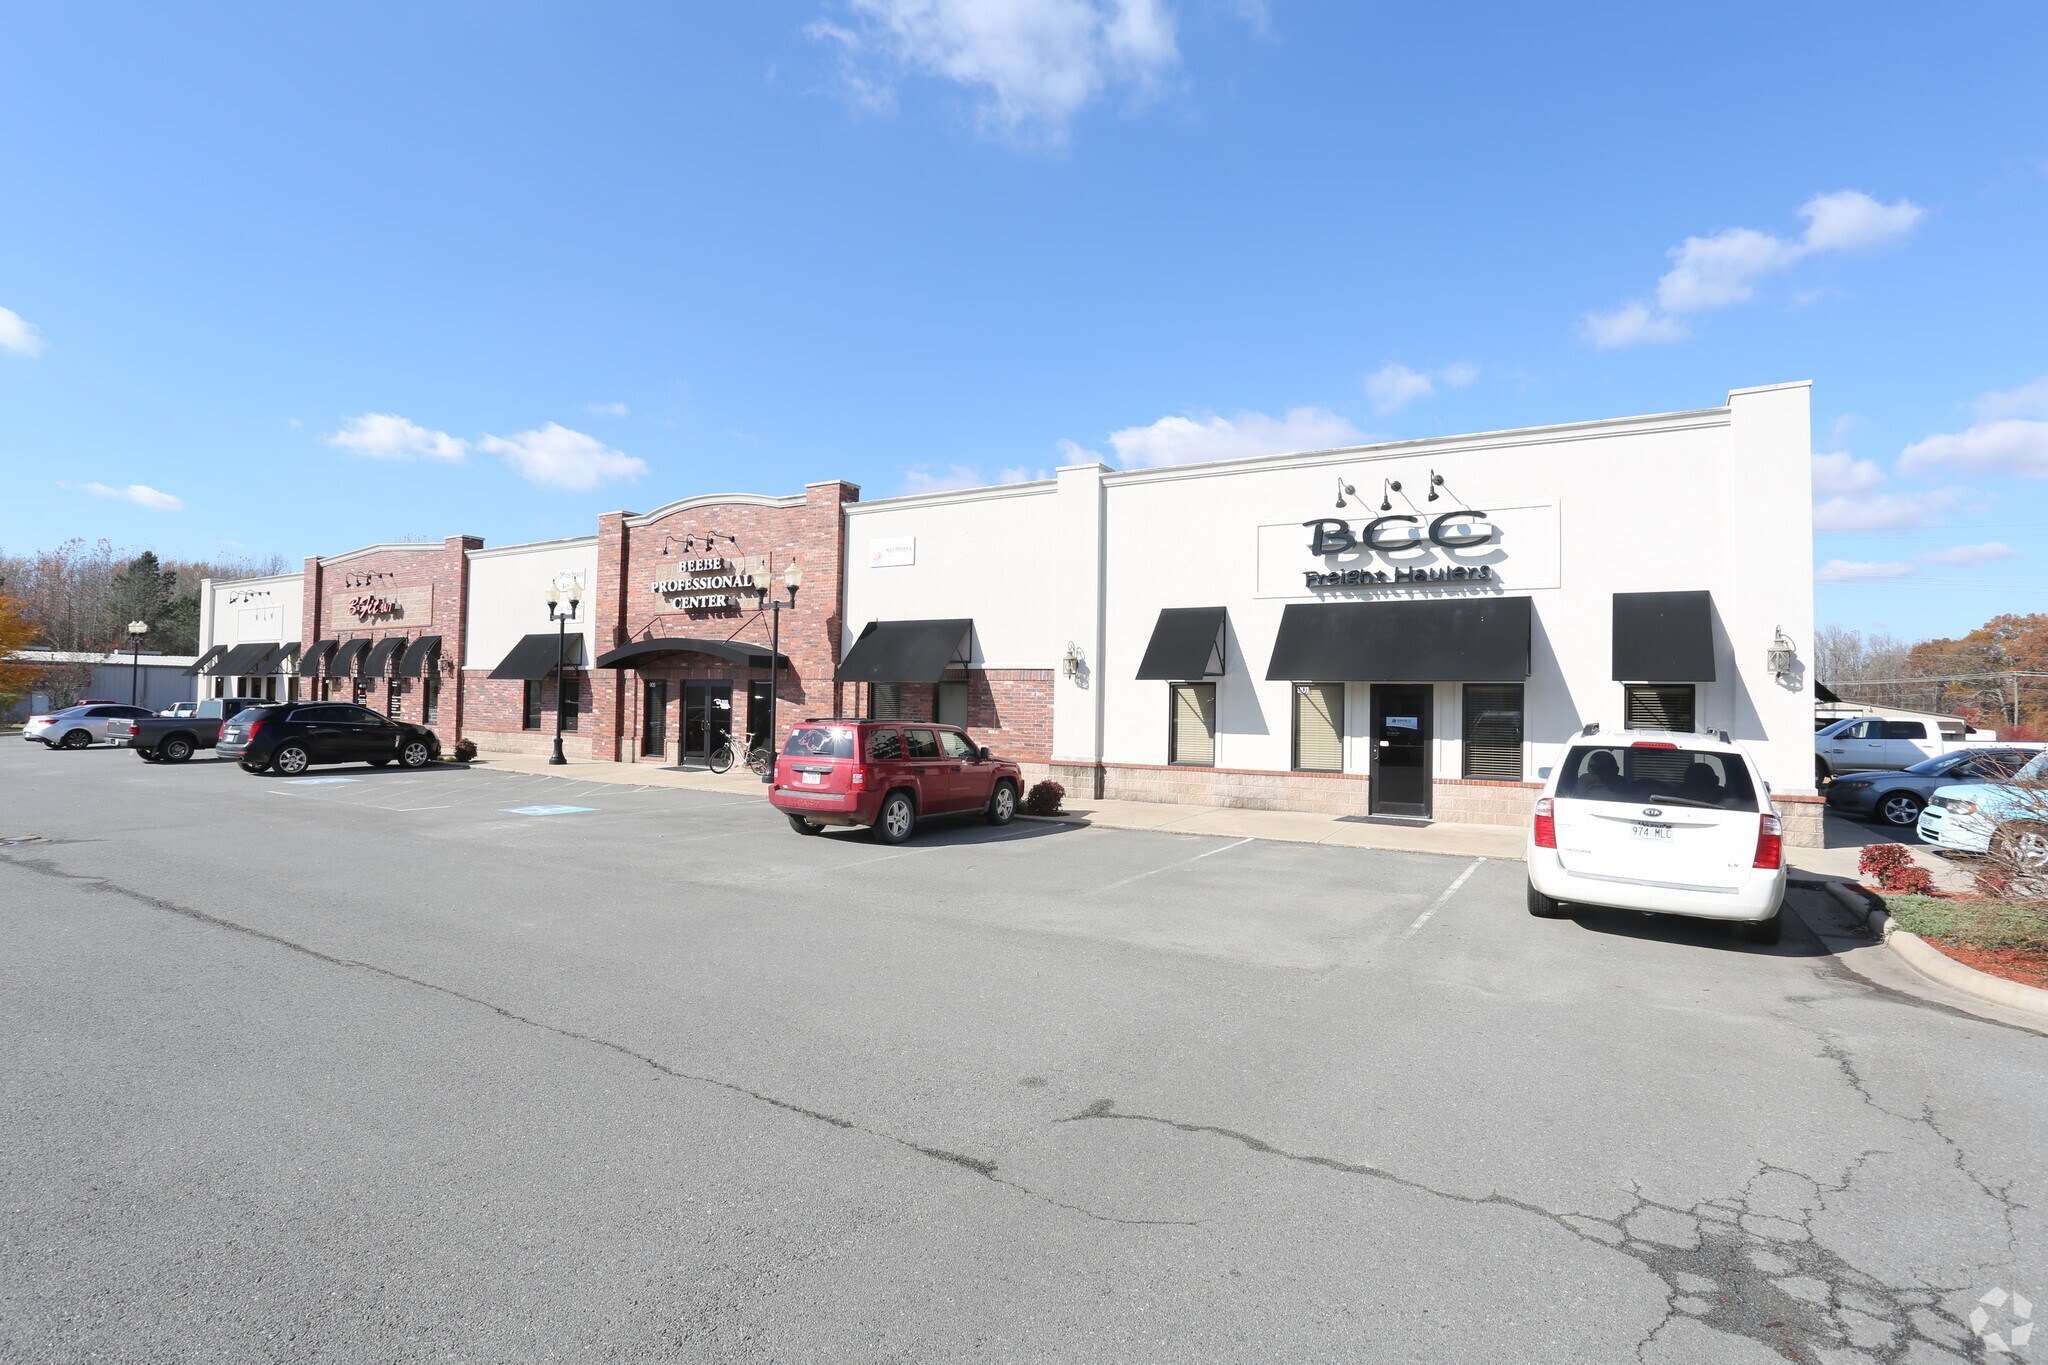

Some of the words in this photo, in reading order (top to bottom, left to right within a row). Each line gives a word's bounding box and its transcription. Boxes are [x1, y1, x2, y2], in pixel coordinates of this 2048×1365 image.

[1302, 510, 1492, 556] BCC
[679, 557, 722, 573] BEEBE
[650, 574, 753, 594] PROFESSIONAL
[1302, 568, 1387, 588] Freight
[1394, 565, 1492, 584] Haulers
[672, 594, 727, 610] CENTER
[1644, 808, 1661, 817] KIA
[1632, 826, 1649, 836] 974
[1654, 828, 1672, 839] MLC
